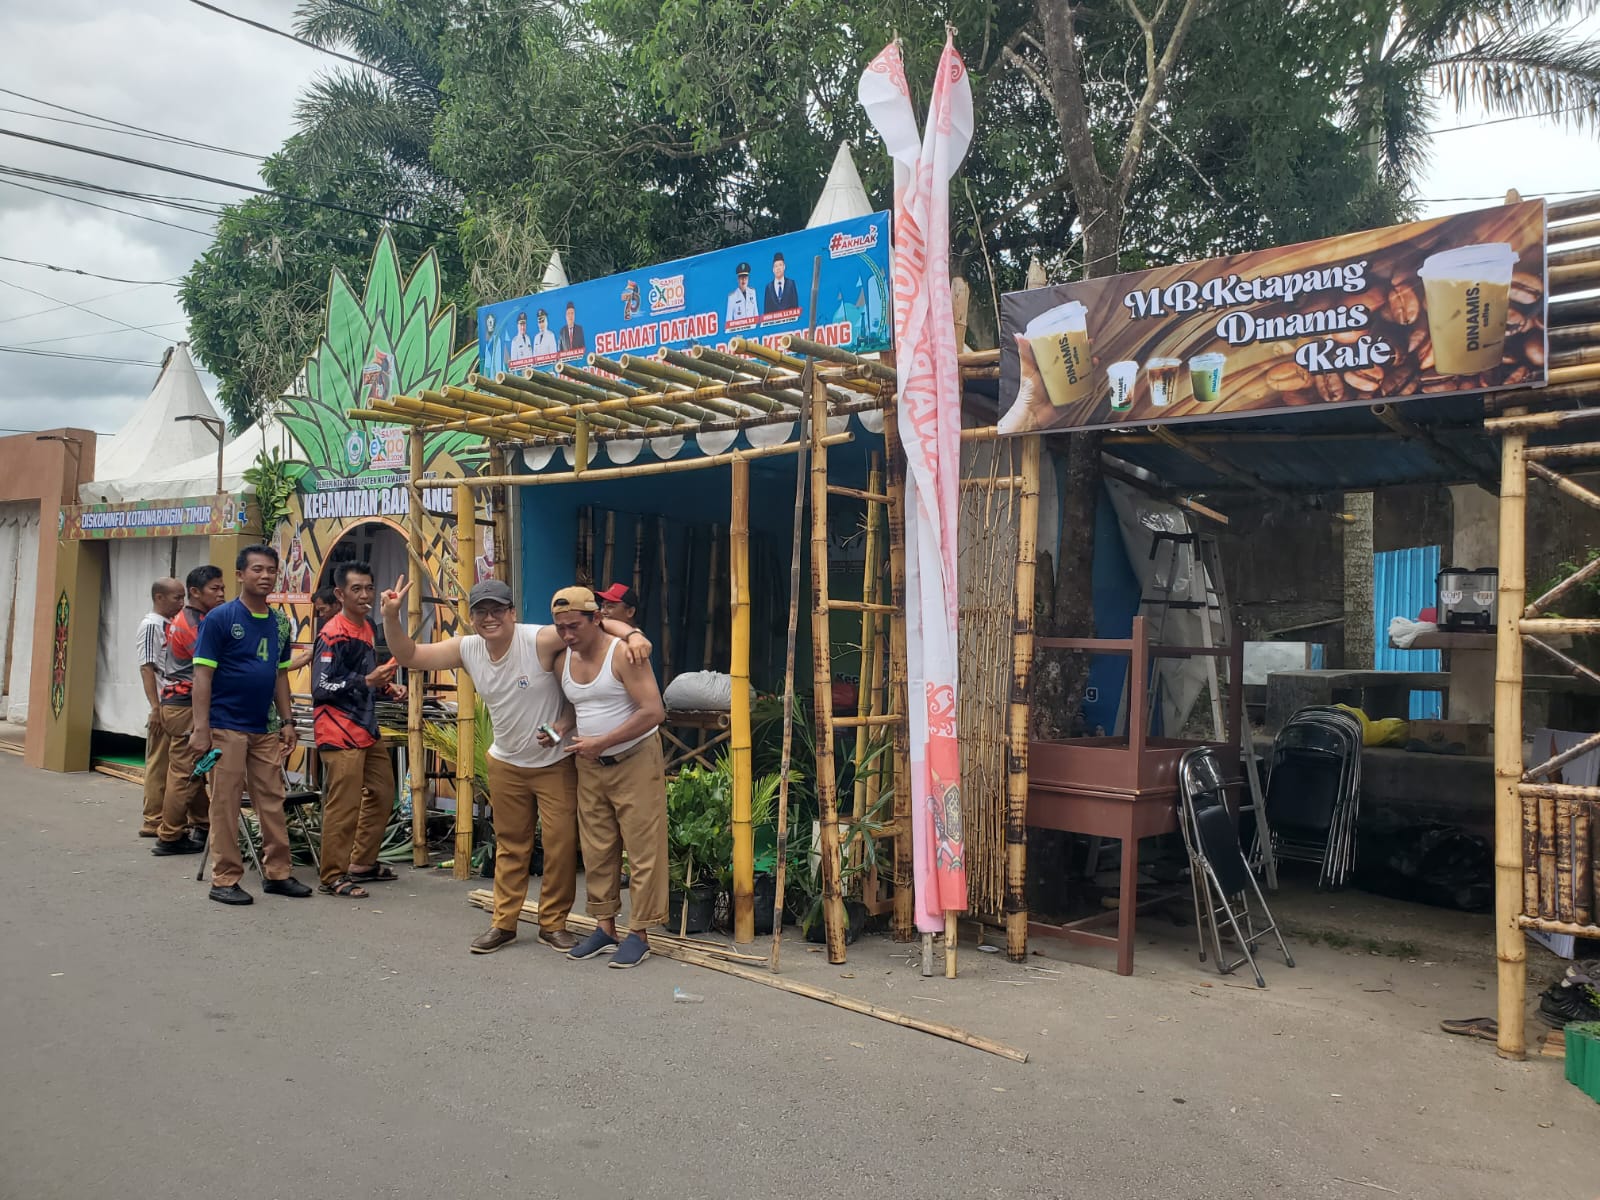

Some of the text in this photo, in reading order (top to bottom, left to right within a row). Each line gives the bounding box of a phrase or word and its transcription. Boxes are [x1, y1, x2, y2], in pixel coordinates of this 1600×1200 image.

[596, 324, 658, 354] SELAMAT
[661, 313, 718, 343] DATANG
[1217, 304, 1369, 345] Dinamis
[1296, 336, 1391, 371] Kafé
[81, 505, 211, 528] DISKOMINFO KOTAWARINGIN TIMUR
[304, 487, 453, 518] KECAMATAN BAAANG
[257, 637, 268, 661] 4
